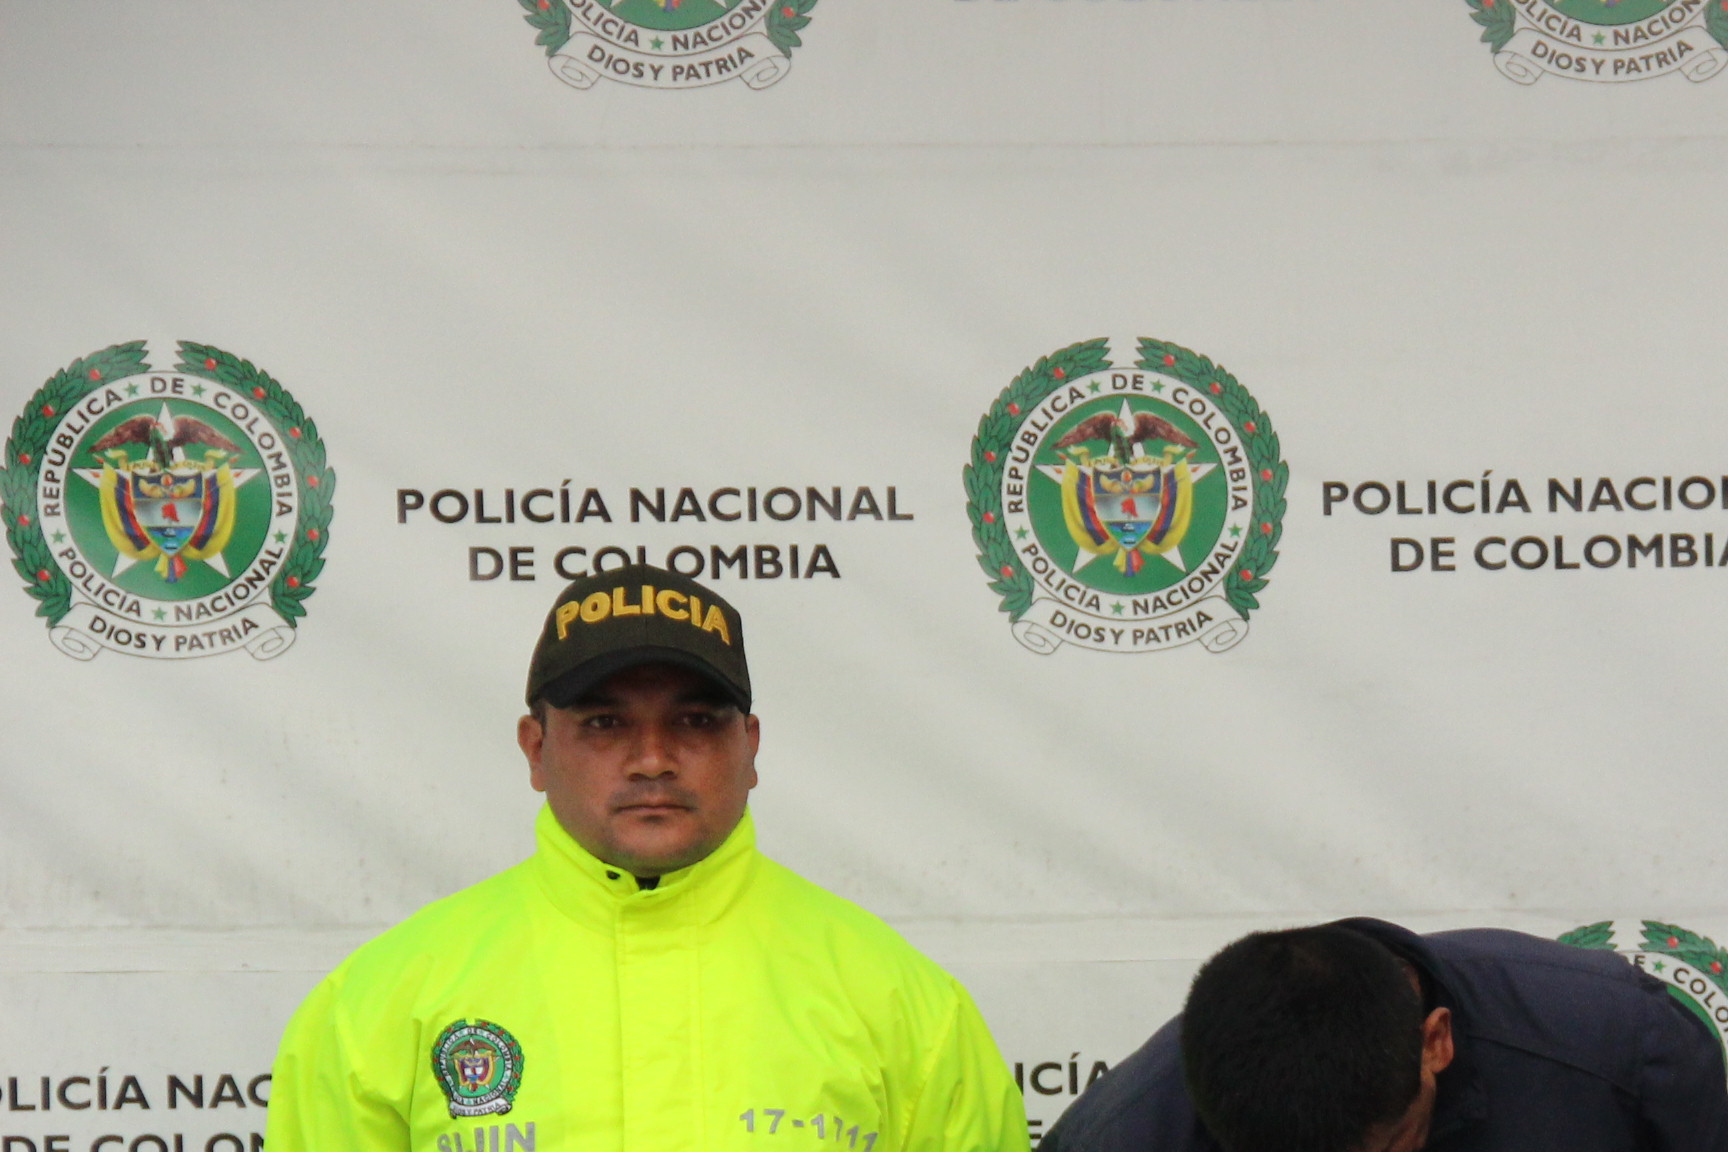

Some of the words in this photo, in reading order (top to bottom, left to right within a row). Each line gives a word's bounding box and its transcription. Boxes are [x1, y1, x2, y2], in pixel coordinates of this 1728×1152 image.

[671, 0, 767, 51] NACION
[671, 46, 755, 81] PATRIA
[1613, 39, 1694, 75] PATRIA
[150, 376, 184, 395] DE
[213, 391, 293, 517] COLOMBIA
[1111, 373, 1144, 390] DE
[1172, 387, 1248, 511] COLOMBIA
[396, 478, 612, 524] POLICÍA
[629, 485, 914, 523] NACIONAL
[1321, 470, 1532, 516] POLICÍA
[468, 545, 536, 581] DE
[1389, 536, 1456, 572] DE
[174, 547, 283, 621] NACIONAL
[1132, 540, 1238, 616] NACIONAL
[174, 617, 258, 651] PATRIA
[555, 584, 731, 646] POLICIA
[1132, 611, 1213, 645] PATRIA
[0, 1066, 151, 1112] LICÍA
